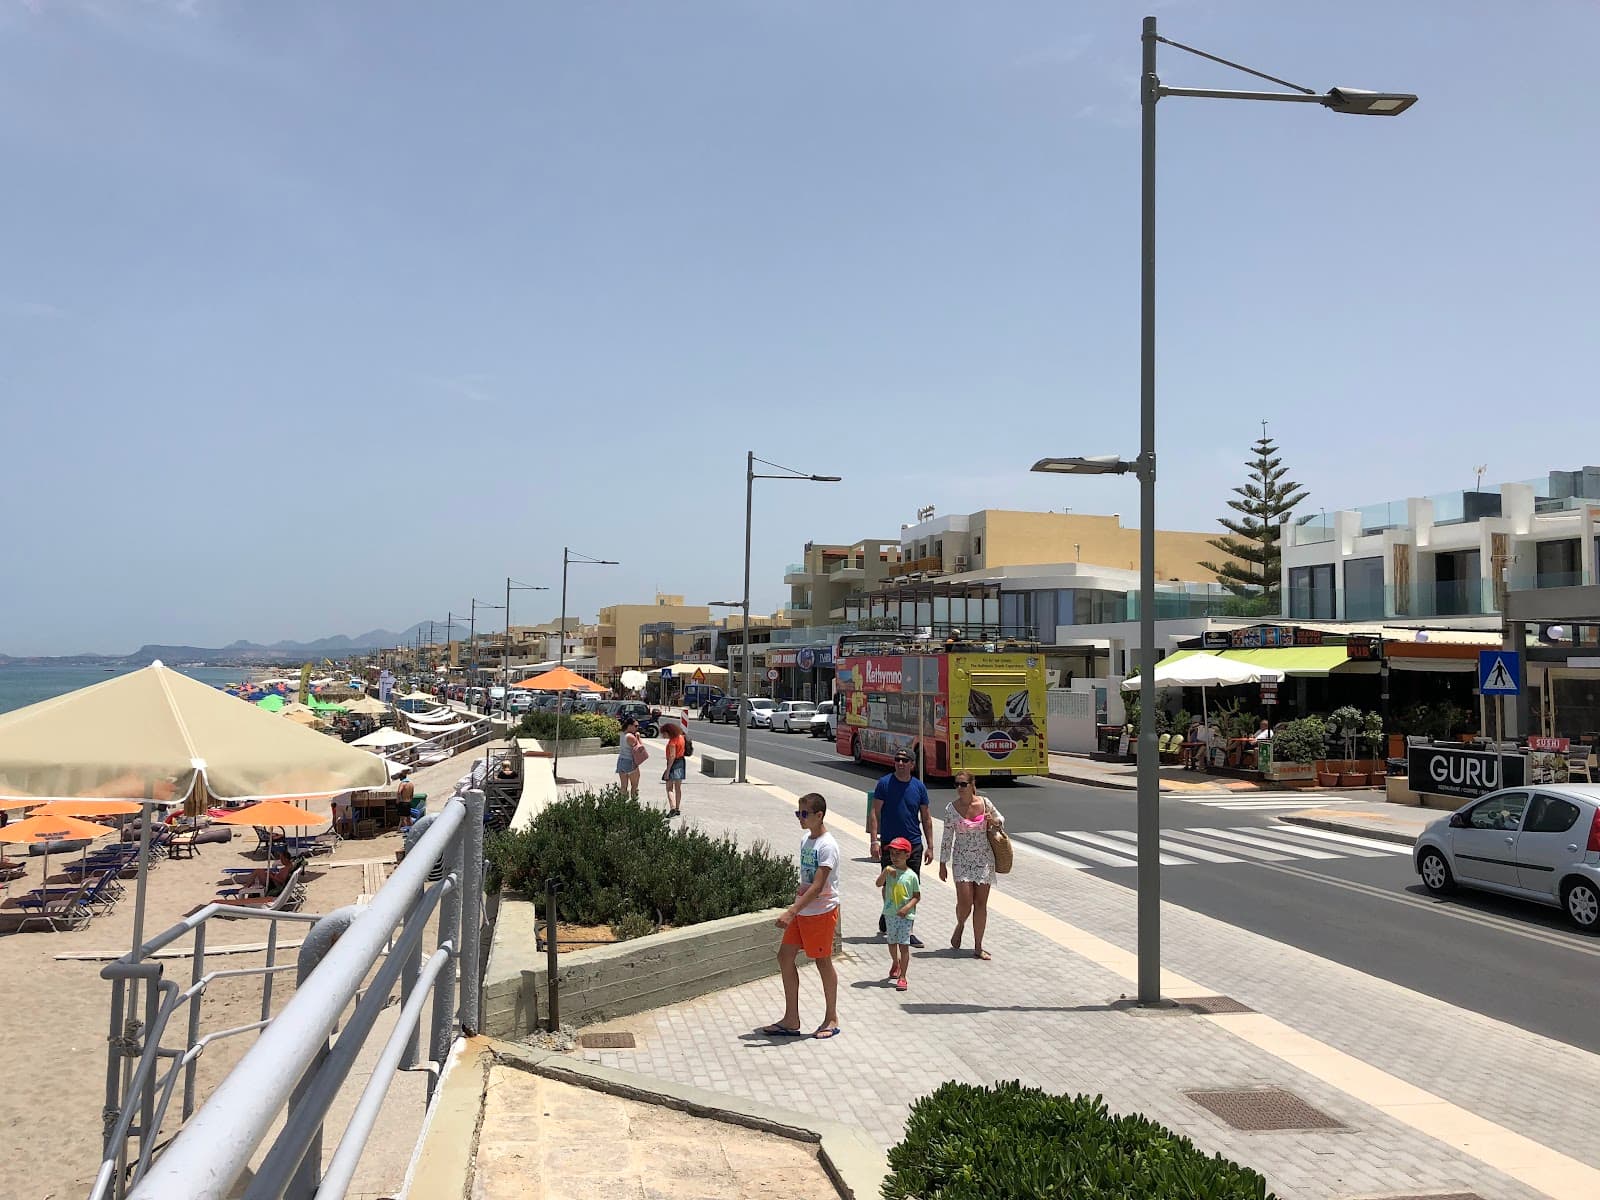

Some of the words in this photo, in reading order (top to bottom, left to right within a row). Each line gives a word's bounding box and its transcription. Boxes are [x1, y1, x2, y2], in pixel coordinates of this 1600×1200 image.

[1348, 646, 1370, 657] PUB
[866, 660, 902, 689] Rethymno
[1536, 738, 1560, 748] SUSHI
[1430, 755, 1498, 788] GURU
